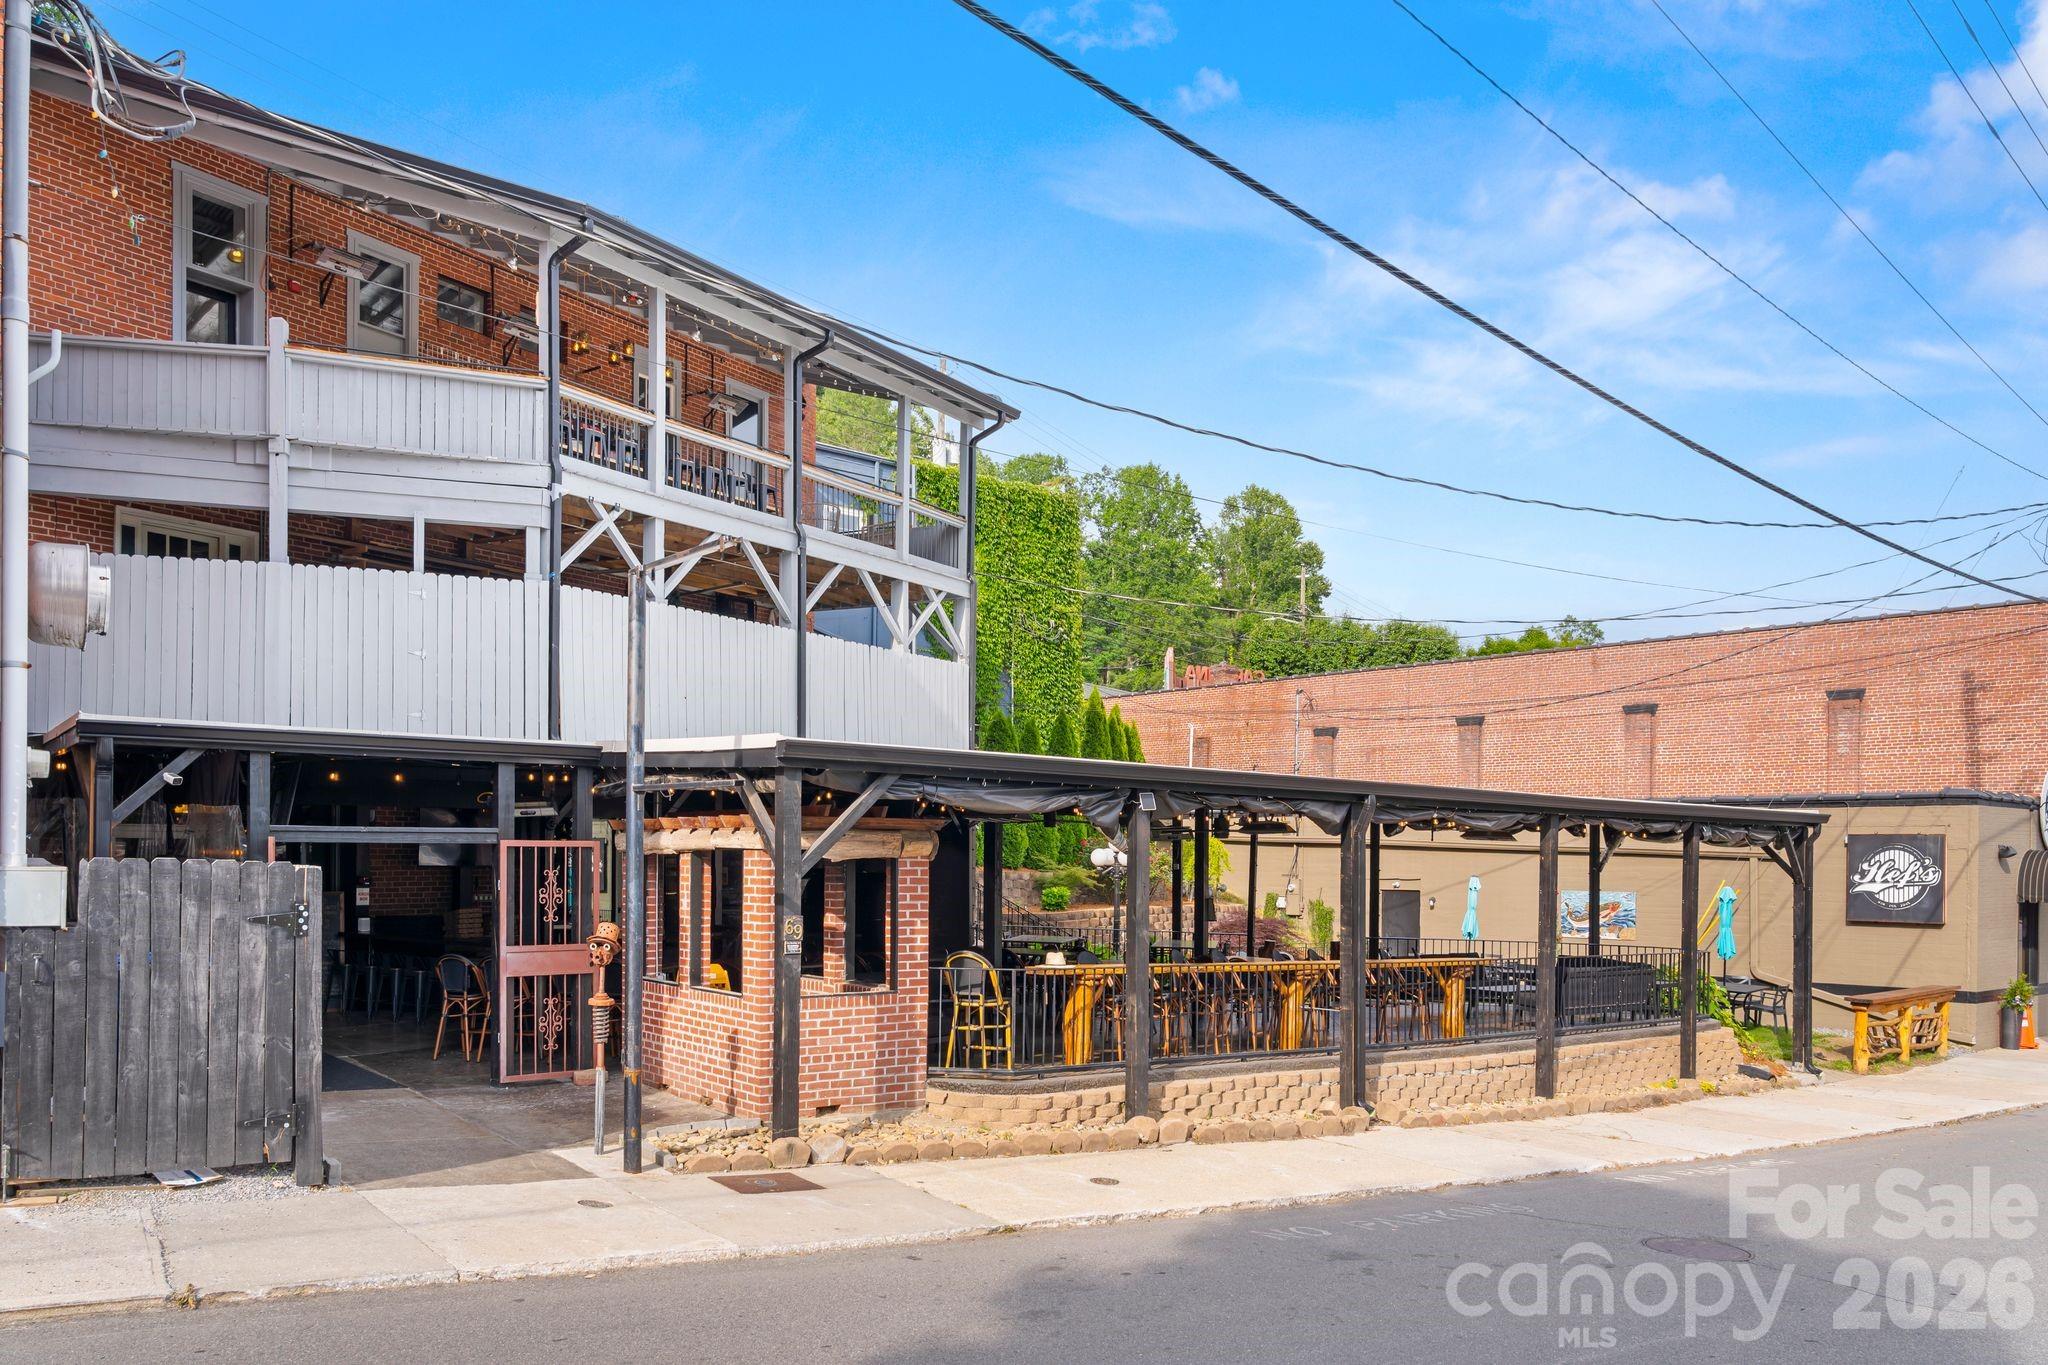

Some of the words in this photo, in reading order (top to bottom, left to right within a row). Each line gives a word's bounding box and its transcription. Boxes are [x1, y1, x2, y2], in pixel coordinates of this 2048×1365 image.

[1852, 858, 1940, 890] Hef's
[785, 917, 803, 940] 69
[1250, 1226, 1334, 1242] NO
